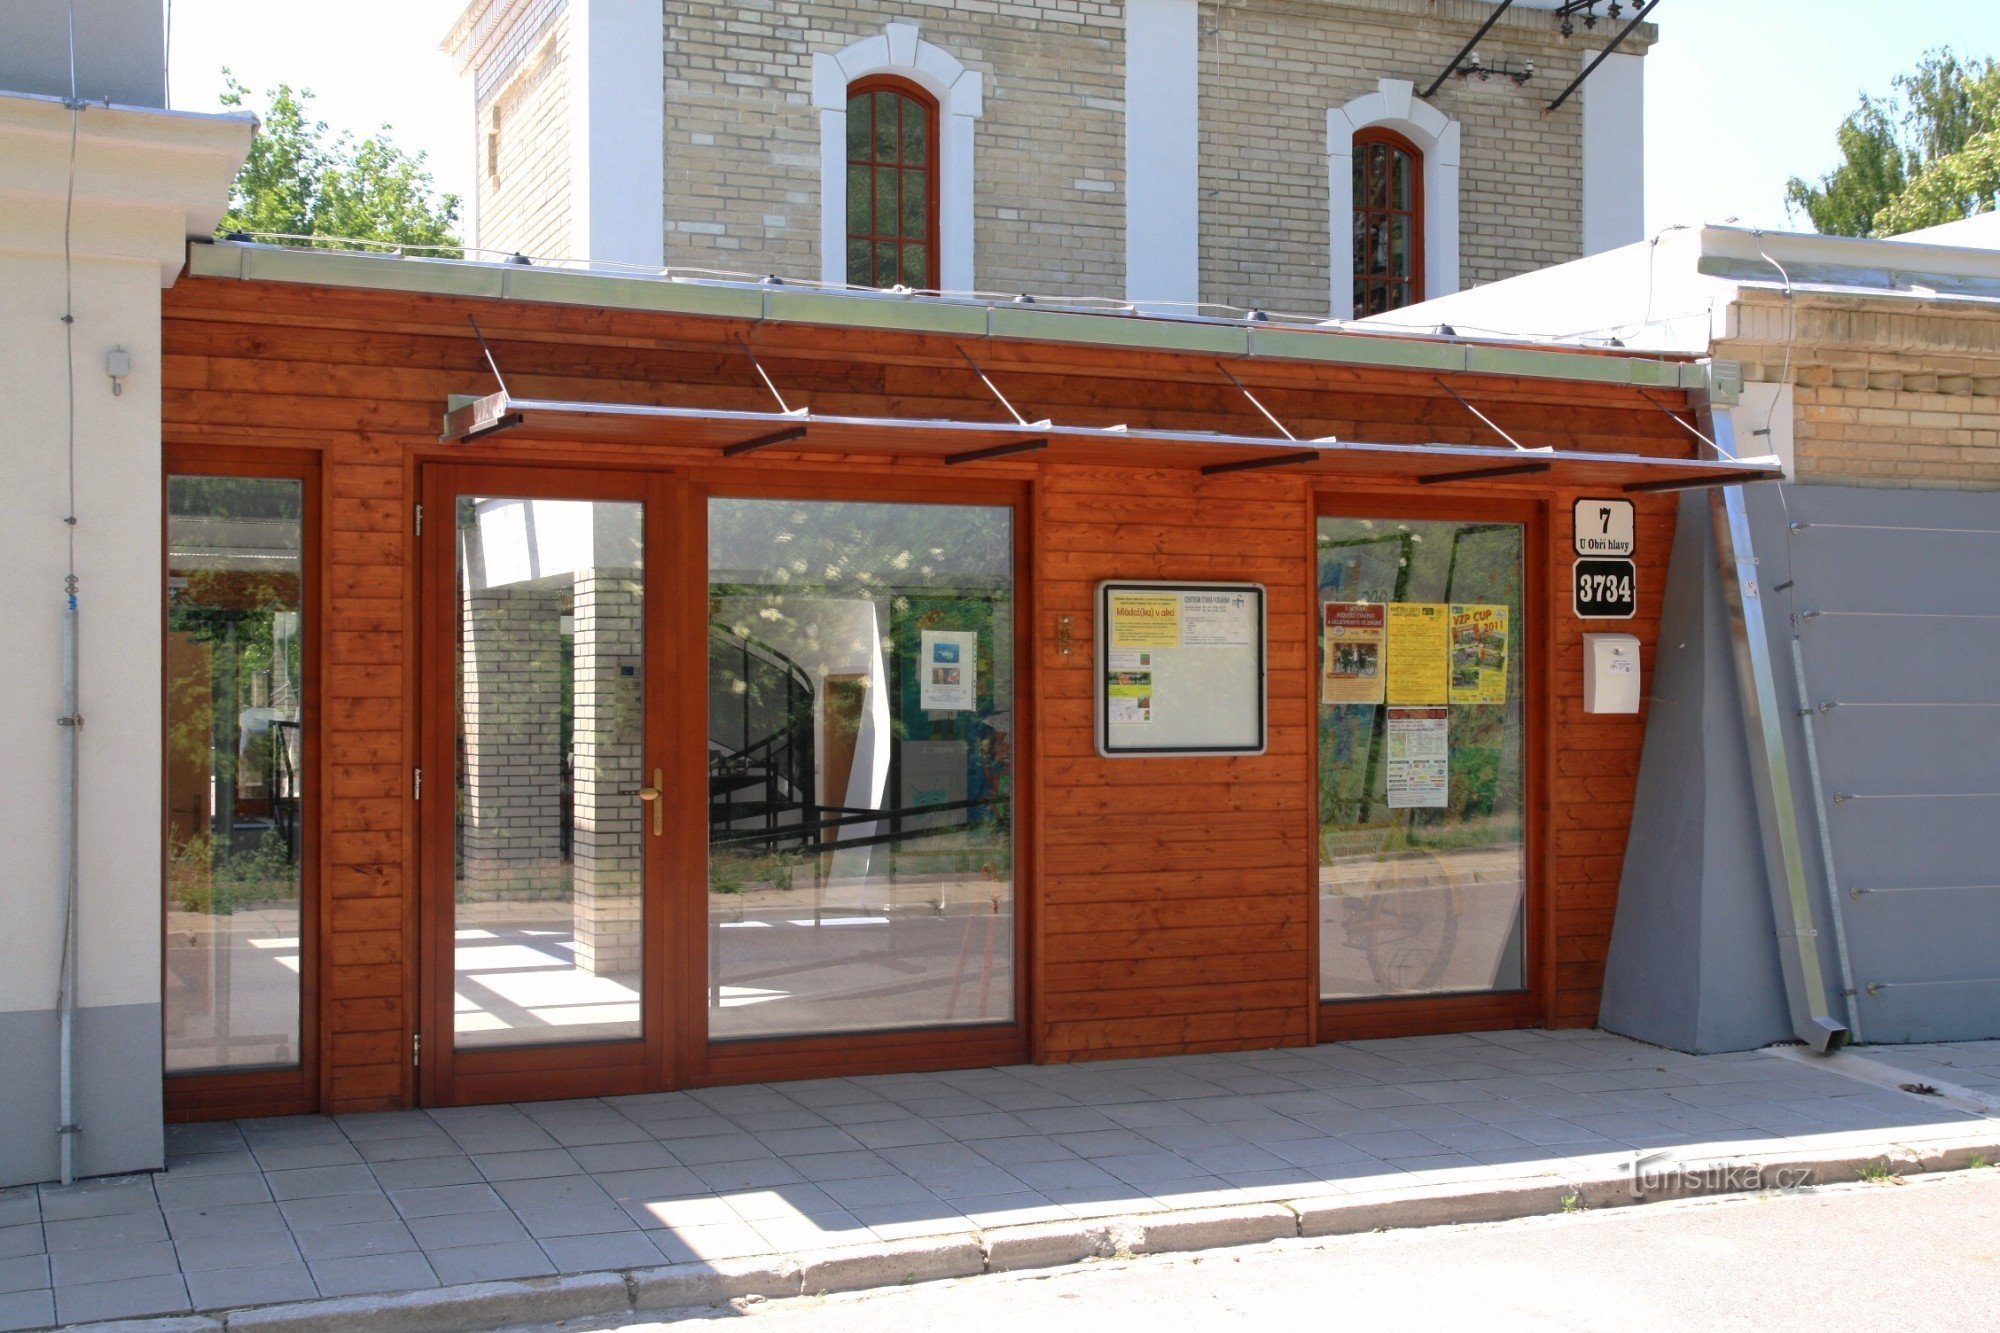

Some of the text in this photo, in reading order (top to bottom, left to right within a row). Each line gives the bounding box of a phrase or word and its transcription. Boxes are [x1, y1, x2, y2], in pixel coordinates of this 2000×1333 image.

[1600, 507, 1611, 534] 7
[1580, 536, 1629, 553] U Obří hlavy
[1580, 574, 1632, 603] 3734
[1473, 609, 1492, 622] CUP
[1483, 620, 1504, 632] 2011
